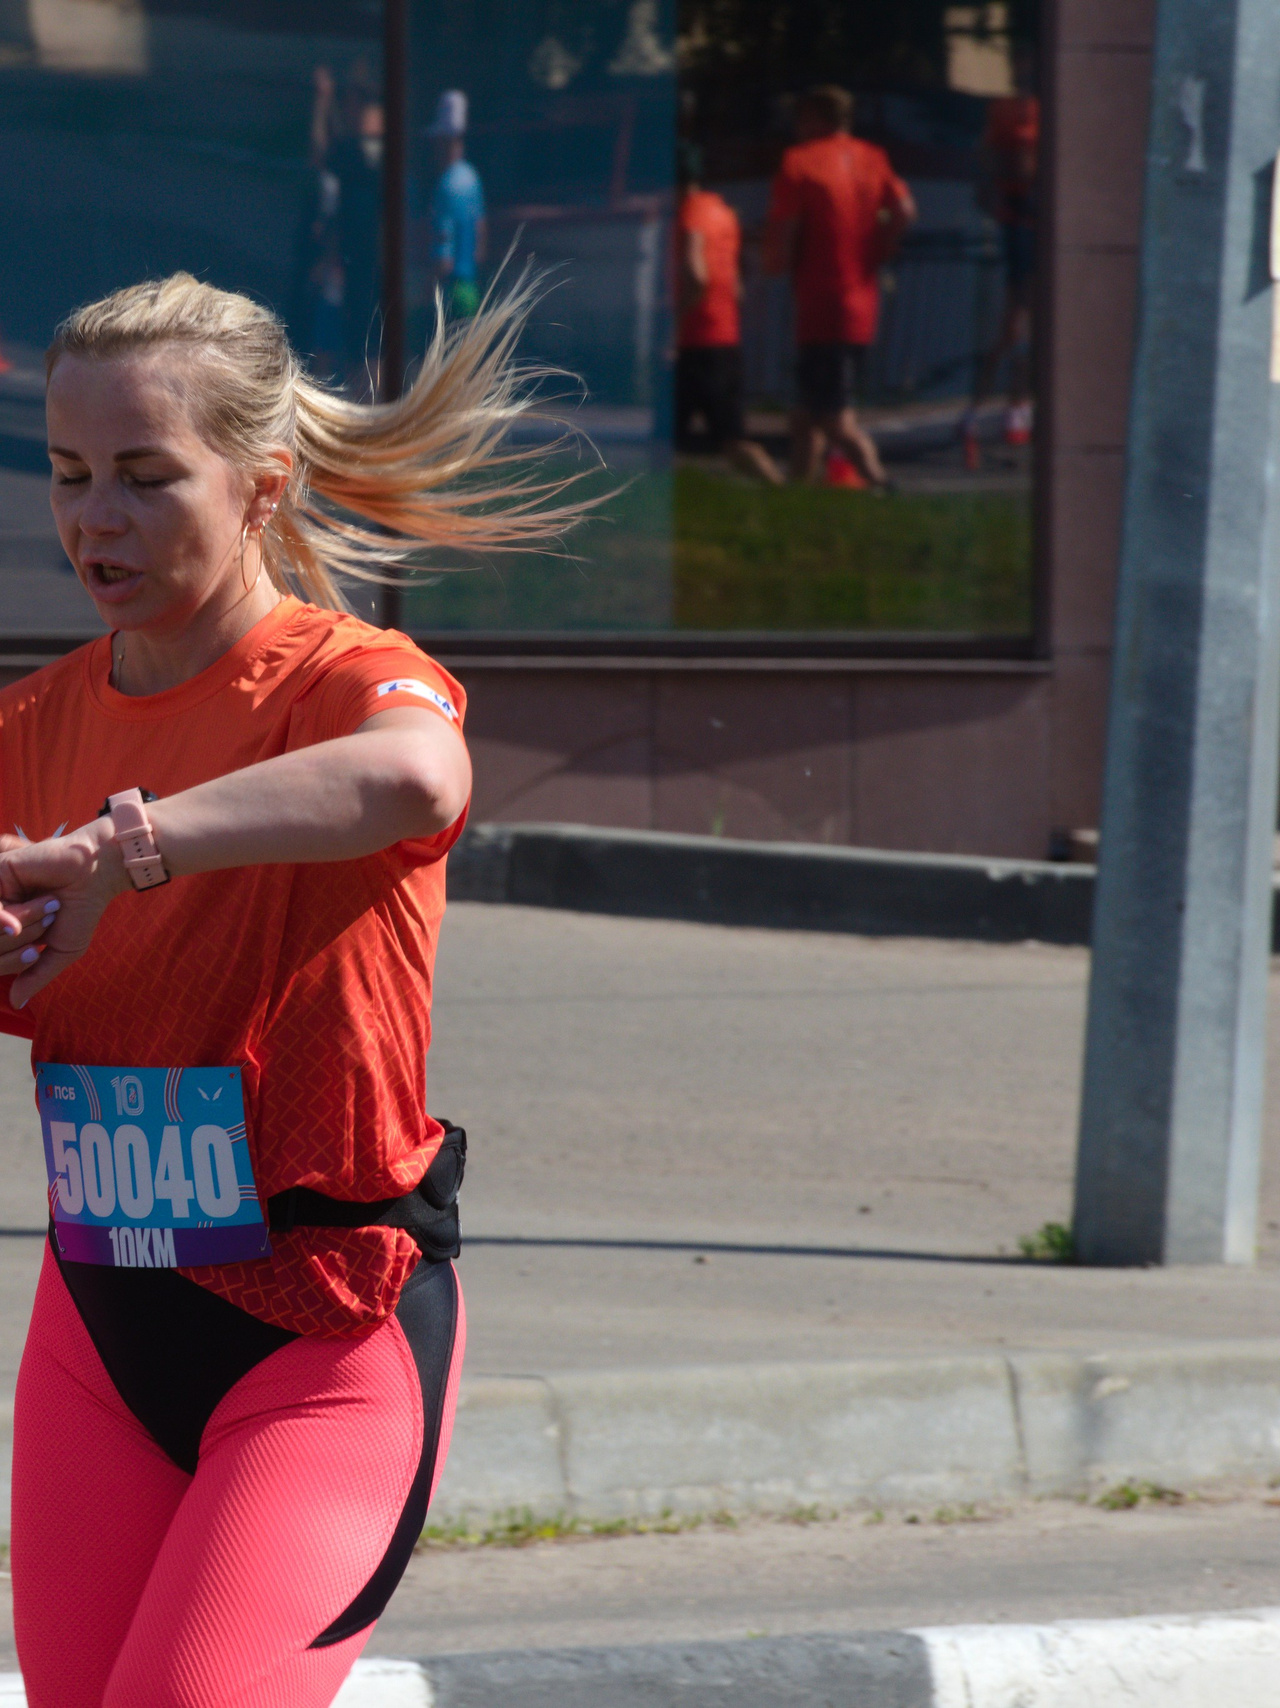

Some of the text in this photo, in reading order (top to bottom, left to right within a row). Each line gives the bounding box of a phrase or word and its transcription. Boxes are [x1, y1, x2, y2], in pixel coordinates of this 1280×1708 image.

[54, 1085, 76, 1100] ПСБ
[111, 1075, 145, 1116] 10
[49, 1120, 241, 1220] 50040
[109, 1226, 178, 1268] 10KM
